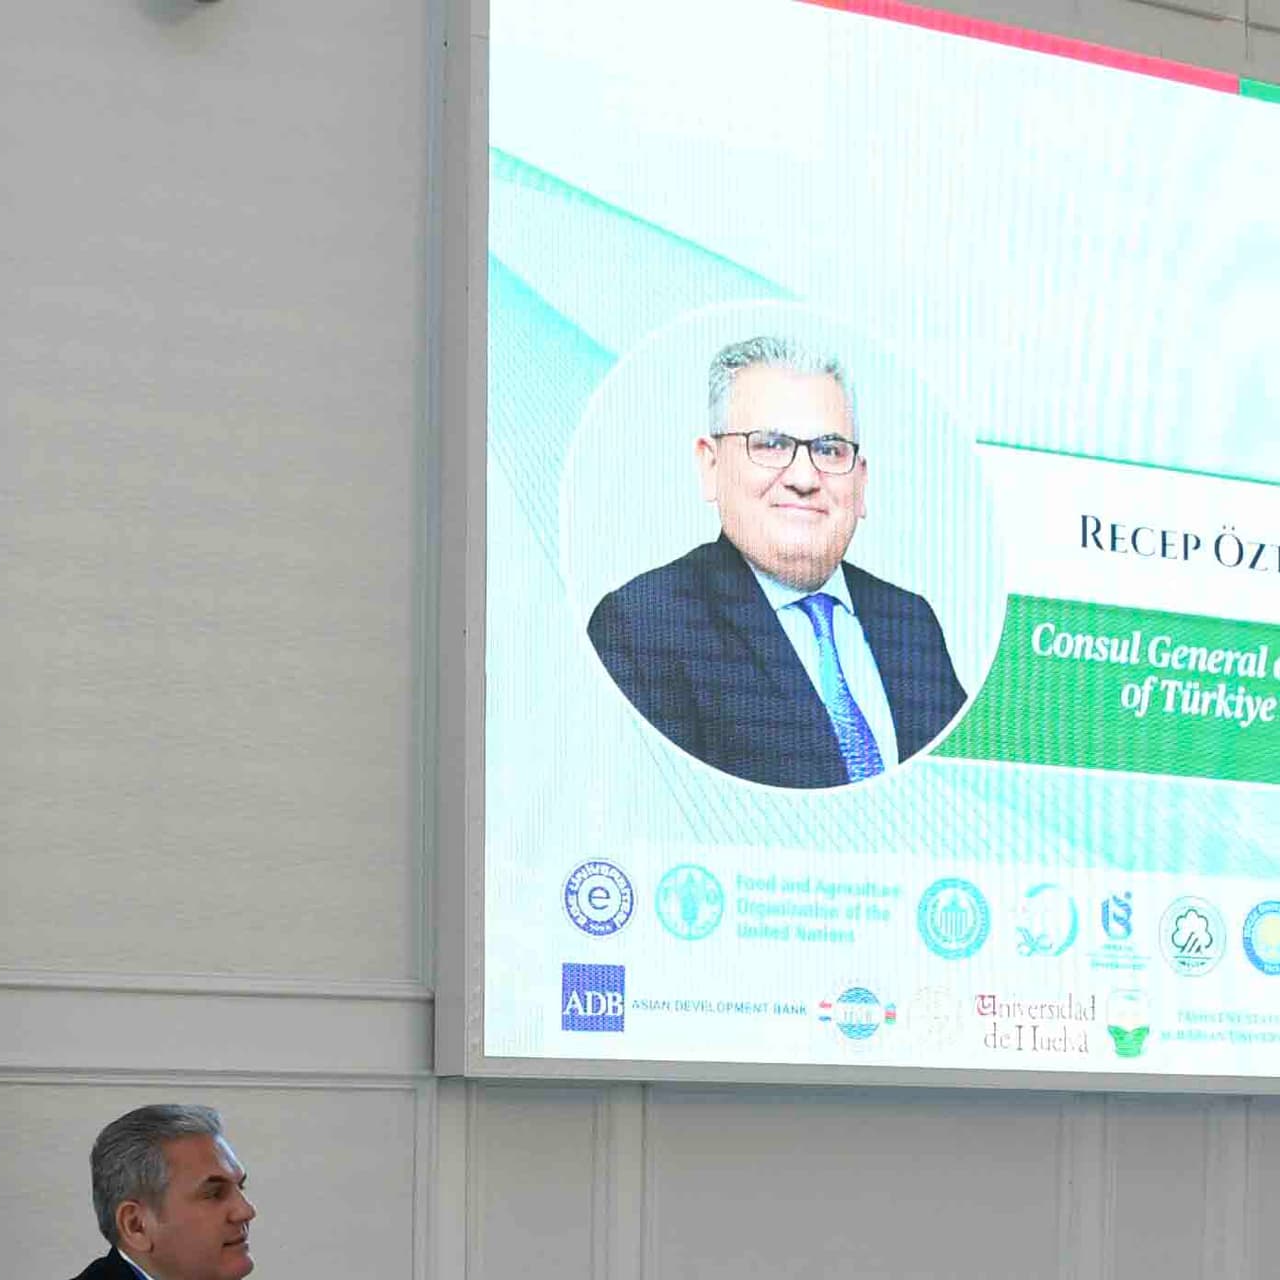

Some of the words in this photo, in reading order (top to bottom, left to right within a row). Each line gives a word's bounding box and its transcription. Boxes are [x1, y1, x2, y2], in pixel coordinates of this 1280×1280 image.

[1081, 514, 1201, 562] RECEP
[1031, 622, 1141, 665] Consul
[1148, 635, 1266, 679] General
[1121, 676, 1156, 719] of
[1161, 682, 1276, 729] Türkiye
[565, 990, 624, 1017] ADB
[632, 999, 670, 1012] ASIAN
[674, 1000, 769, 1014] DEVELOPMENT
[773, 1003, 807, 1016] BANK
[974, 992, 1097, 1022] Universidad
[983, 1022, 1011, 1049] de
